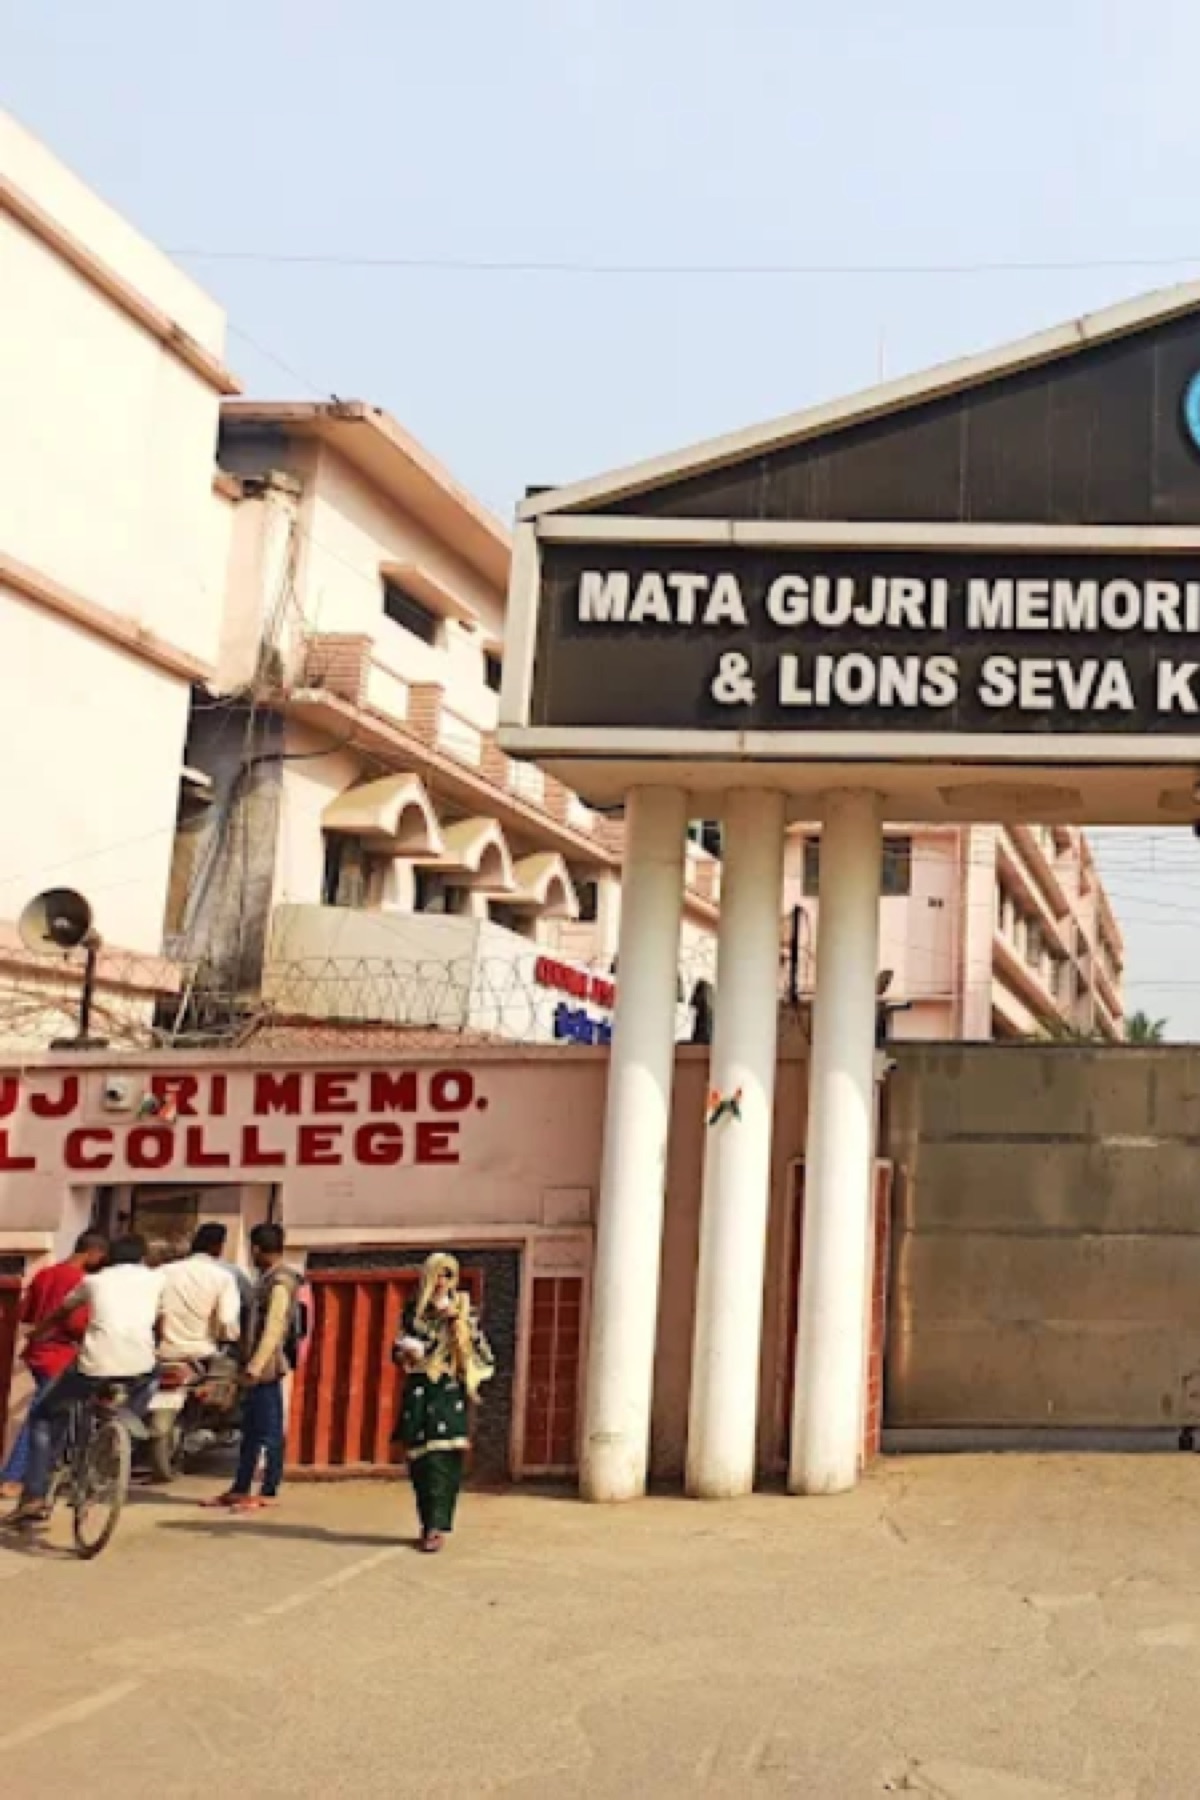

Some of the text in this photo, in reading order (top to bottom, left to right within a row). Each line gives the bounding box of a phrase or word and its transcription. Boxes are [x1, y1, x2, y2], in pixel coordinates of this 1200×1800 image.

[577, 571, 747, 626] MATA
[766, 576, 949, 629] GUJRI
[711, 653, 755, 706] &
[779, 656, 958, 708] LIONS
[978, 659, 1134, 712] SEVA
[252, 1070, 489, 1116] MEMO.
[63, 1122, 460, 1169] COLLEGE
